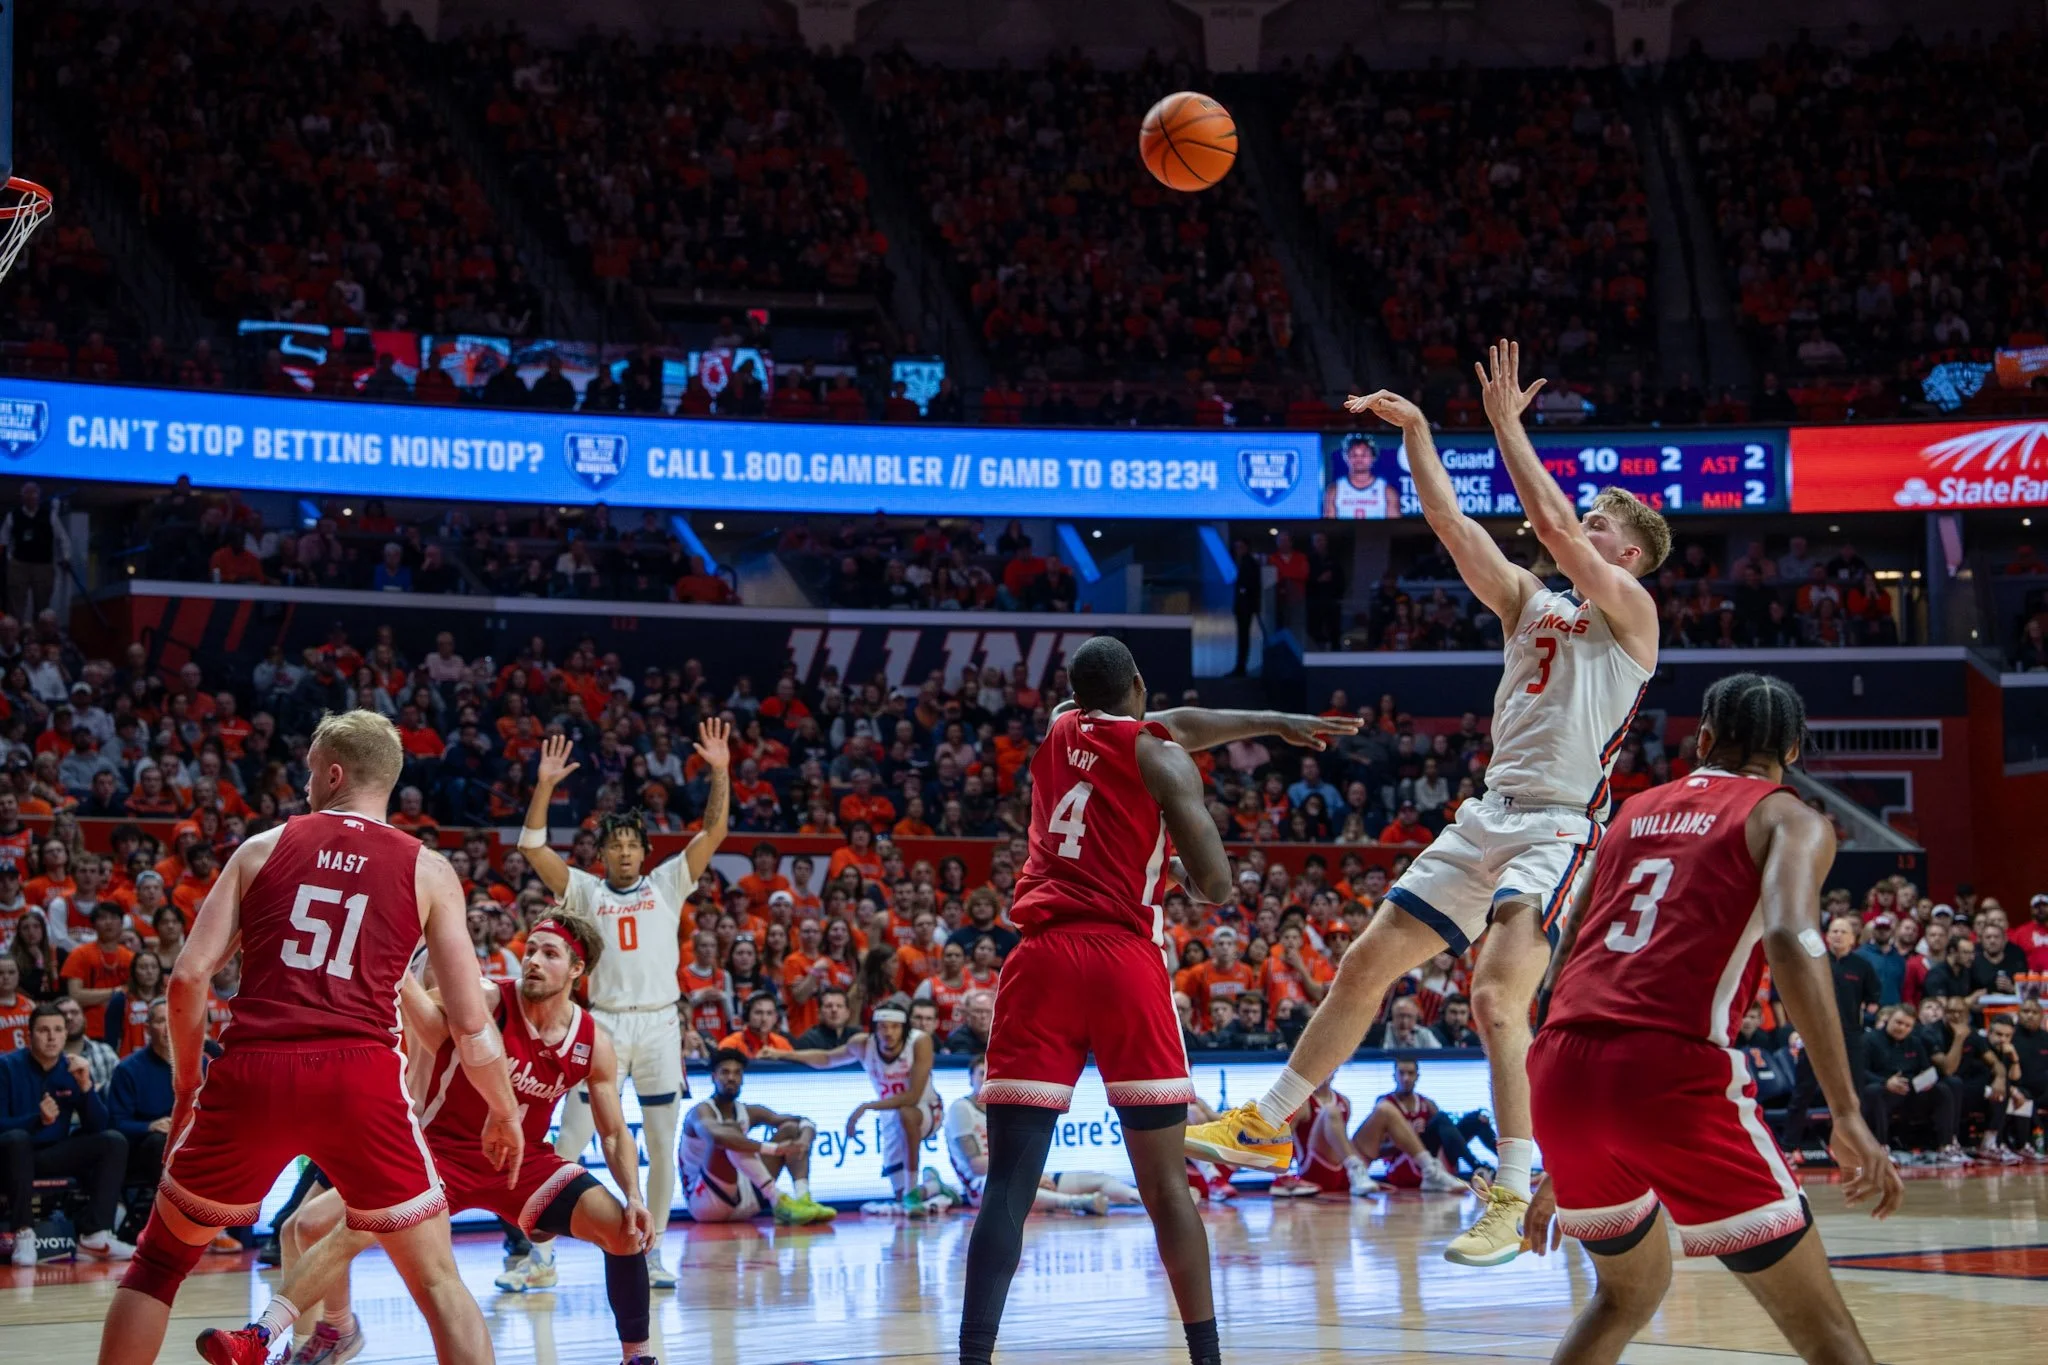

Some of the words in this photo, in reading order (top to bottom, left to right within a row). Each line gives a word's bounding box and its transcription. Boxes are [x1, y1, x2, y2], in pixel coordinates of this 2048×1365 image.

[67, 415, 159, 452] CAN'T
[167, 422, 244, 457] STOP
[253, 427, 382, 466] BETTING
[390, 434, 544, 473] NONSTOP?
[1442, 448, 1496, 470] Guard
[1702, 457, 1740, 474] AST
[1744, 444, 1765, 470] 2
[647, 447, 715, 480] CALL
[721, 450, 943, 487] 1.800.GAMBLER
[979, 457, 1060, 489] GAMB
[1067, 458, 1102, 489] TO
[1110, 459, 1218, 490] 833234
[1543, 459, 1577, 477] PTS
[1578, 447, 1619, 473] 10
[1621, 458, 1658, 475] REB
[1661, 446, 1682, 471] 2
[1495, 493, 1522, 513] JR.
[1664, 483, 1682, 509] 1
[1702, 491, 1742, 510] MIN
[1744, 479, 1766, 505] 2
[1525, 637, 1557, 695] 3
[1048, 780, 1094, 860] 4
[1630, 812, 1717, 839] WILLIAMS
[316, 849, 369, 874] MAST
[597, 900, 656, 916] ILLINOIS
[1603, 857, 1676, 953] 3
[279, 884, 370, 981] 51
[618, 916, 638, 951] 0
[35, 1236, 76, 1250] OYOTA
